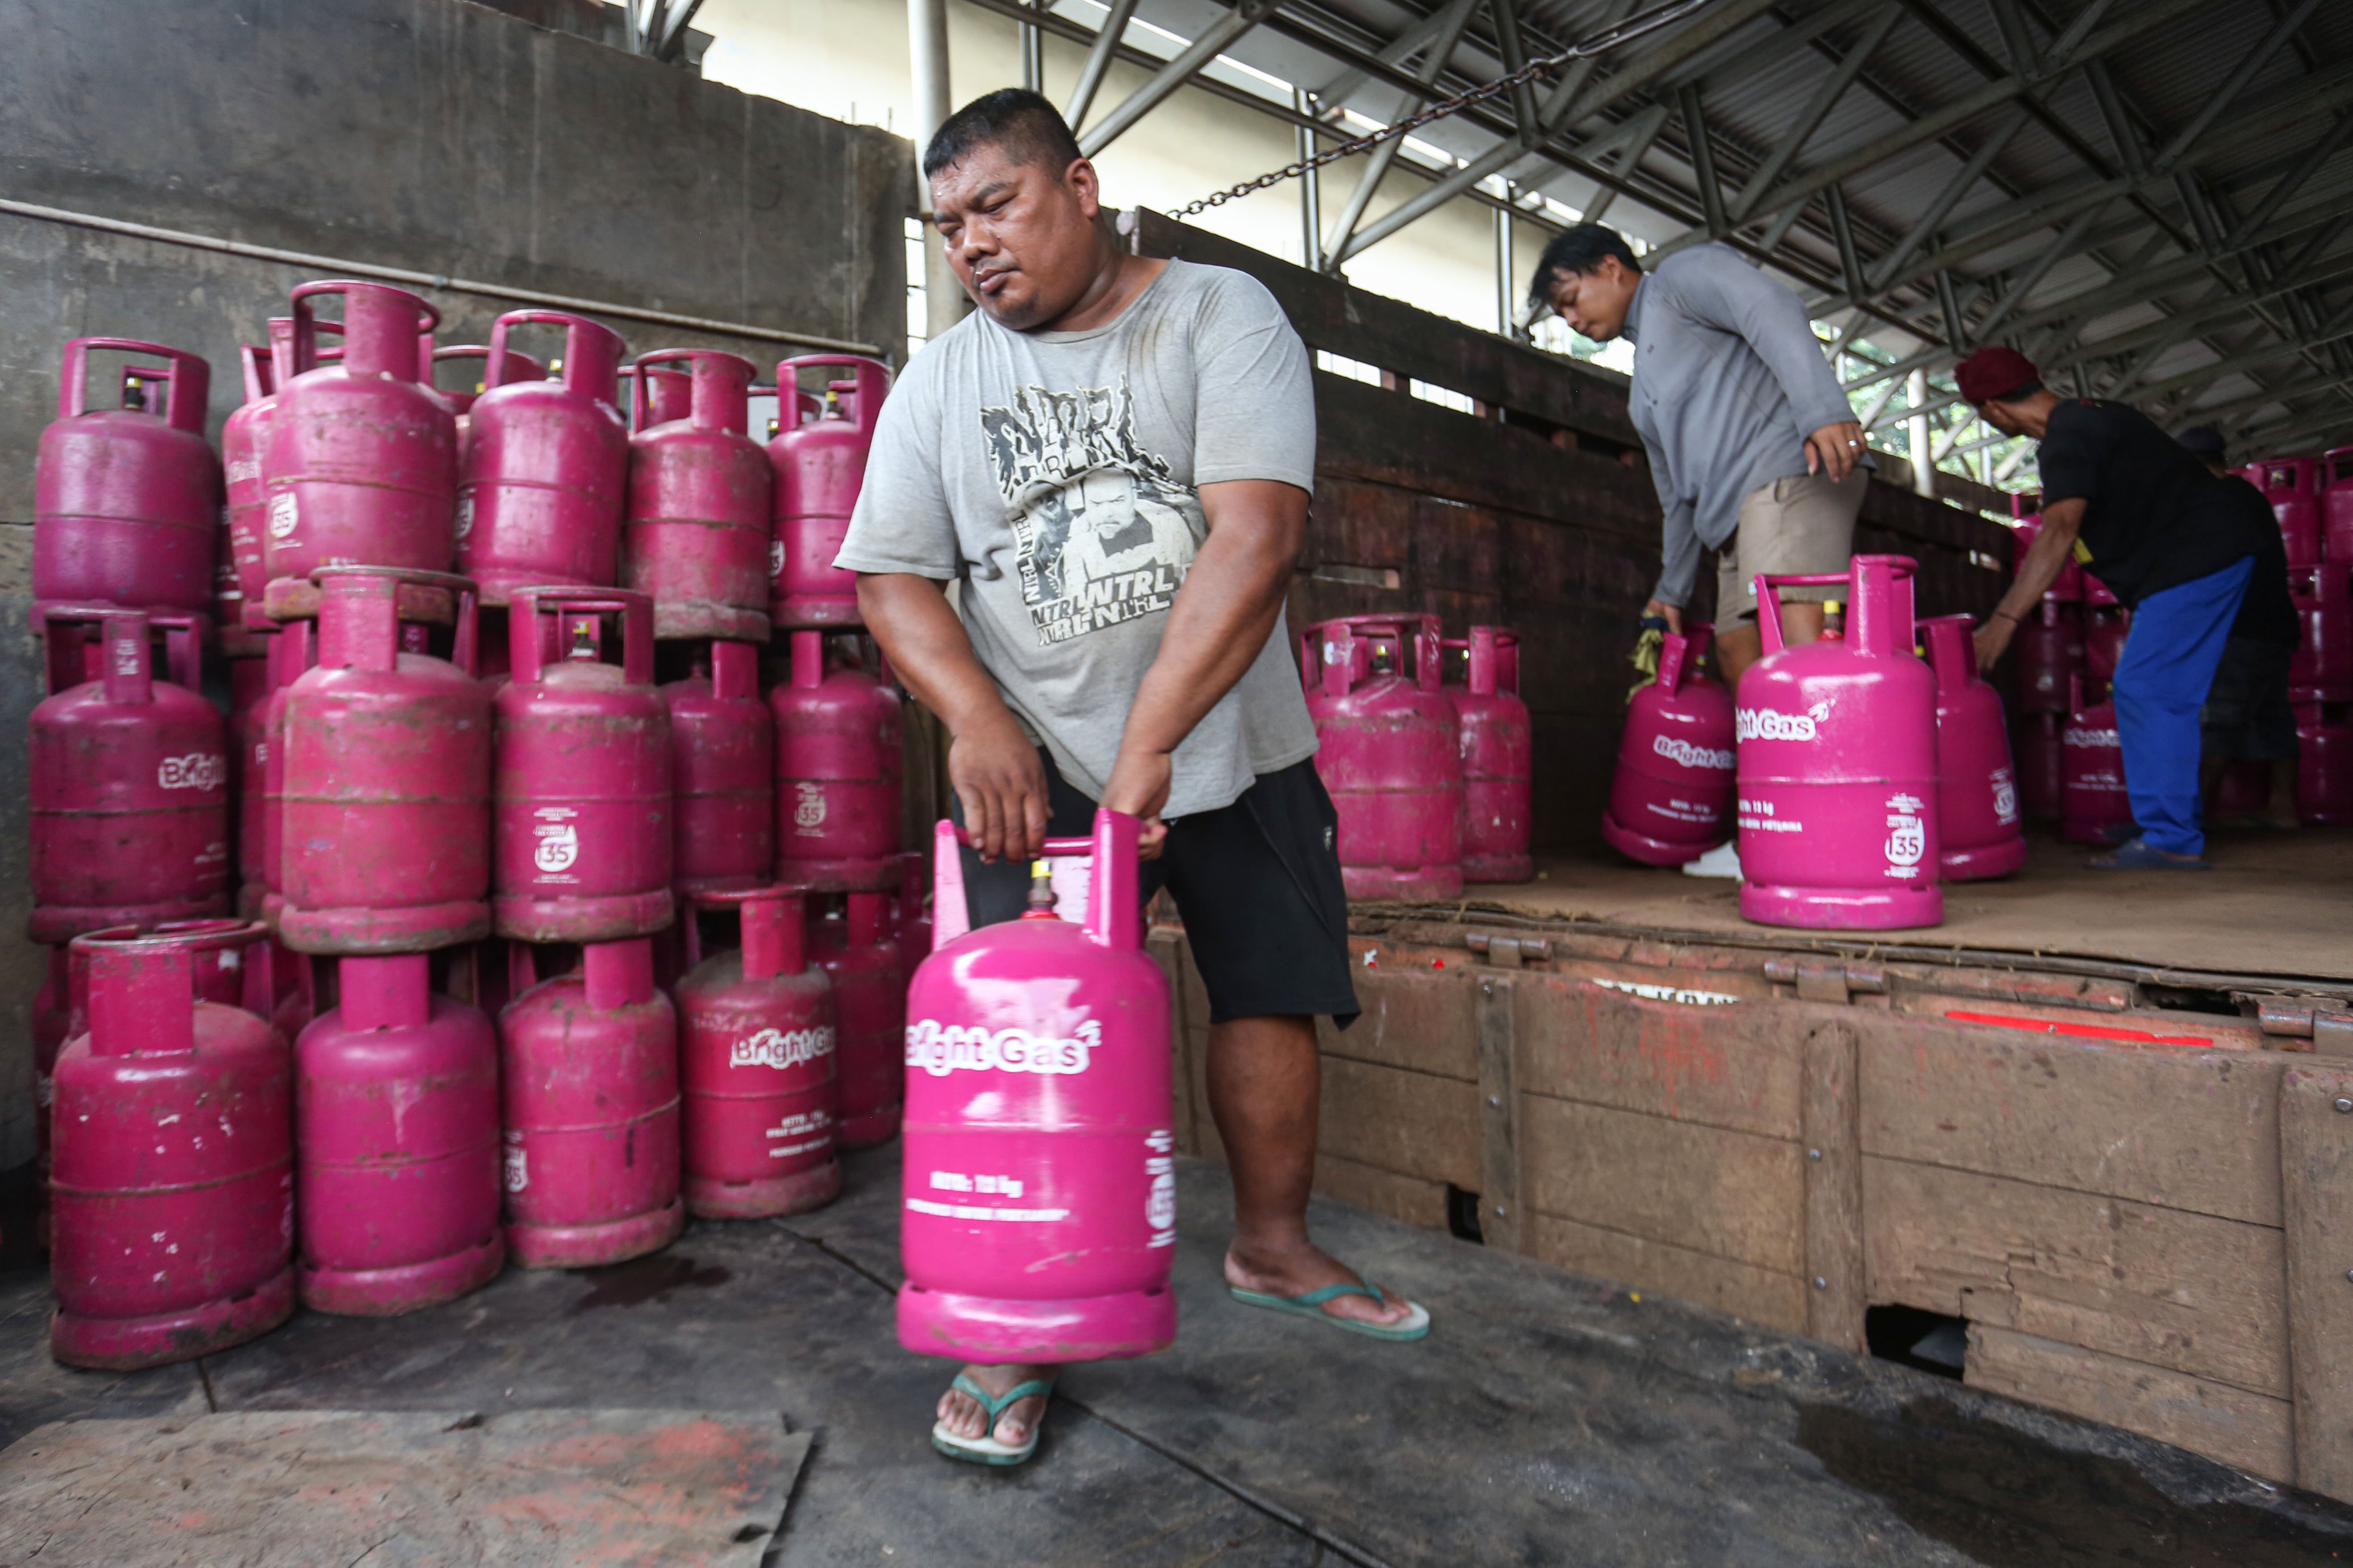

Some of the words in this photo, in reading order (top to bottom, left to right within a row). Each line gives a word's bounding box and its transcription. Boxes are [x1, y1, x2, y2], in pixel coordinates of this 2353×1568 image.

[1087, 567, 1174, 606] NTRL
[1758, 707, 1816, 742] Gas
[1889, 836, 1919, 856] 135
[731, 1028, 814, 1069] Bright
[992, 1028, 1090, 1075] Gas
